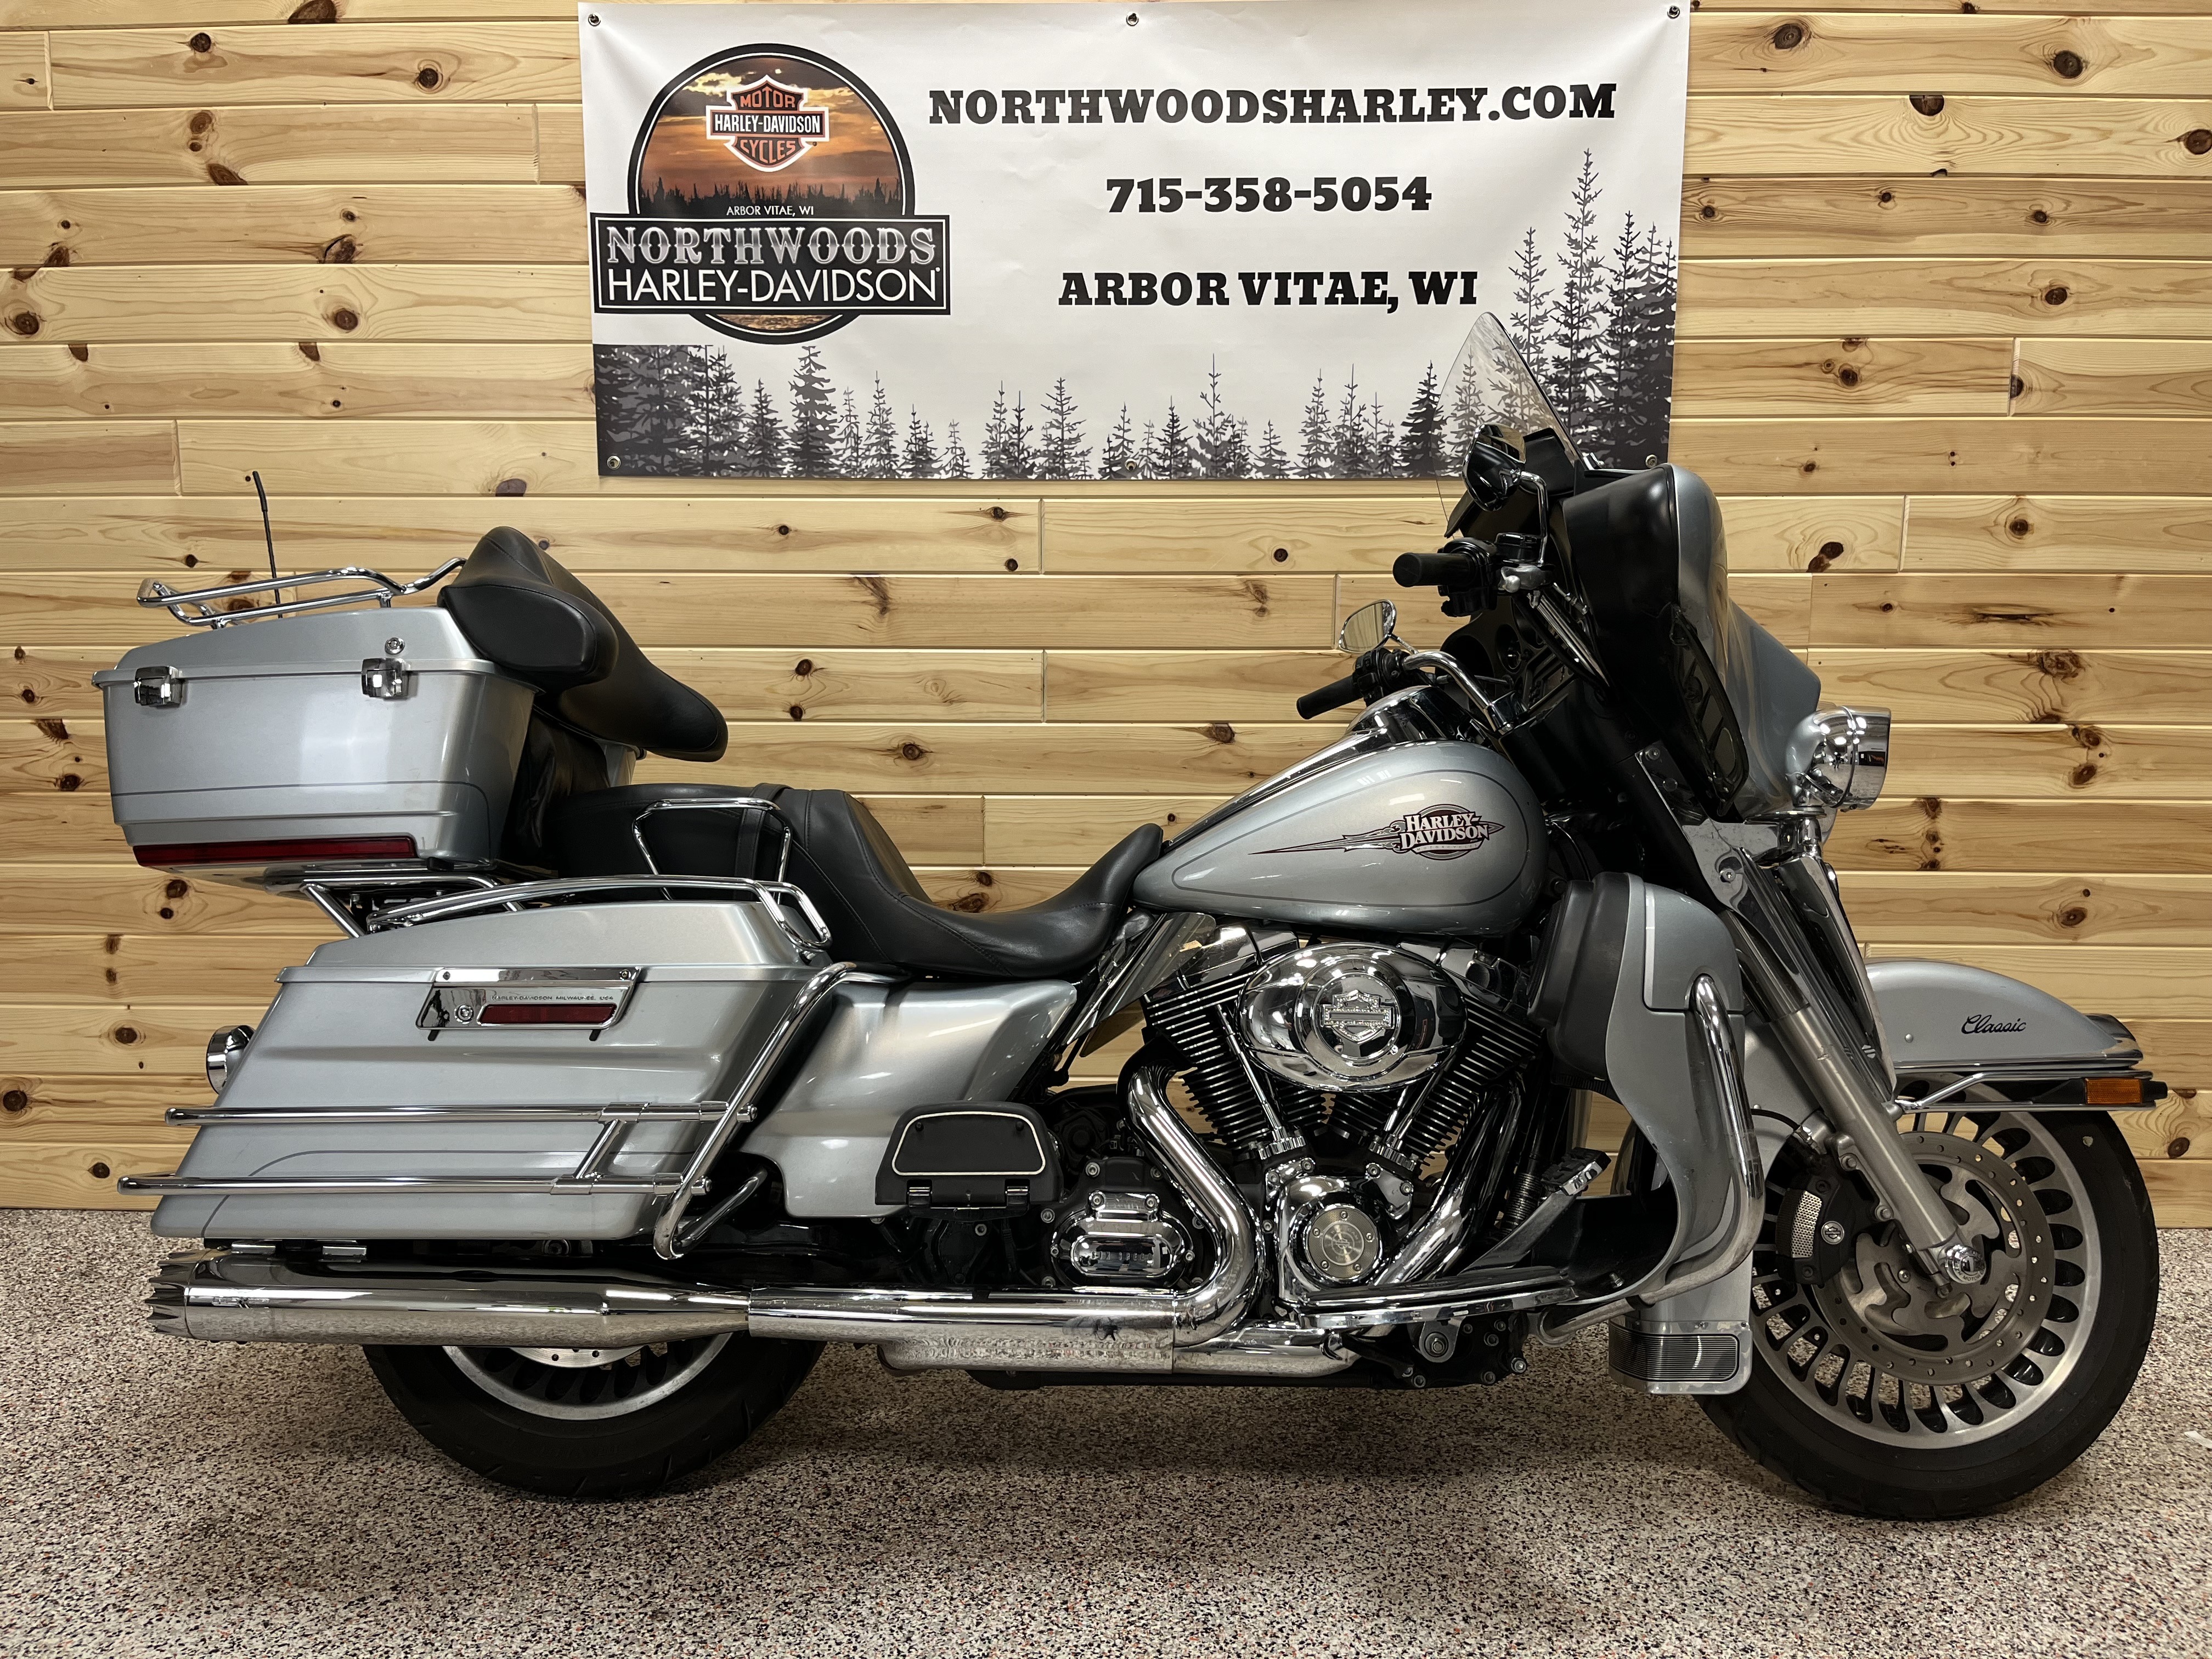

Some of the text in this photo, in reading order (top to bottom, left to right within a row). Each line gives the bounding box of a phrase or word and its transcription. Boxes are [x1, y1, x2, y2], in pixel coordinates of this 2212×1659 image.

[740, 86, 795, 108] MOTOR
[929, 83, 1617, 125] NORTHWOODSHARLEY.COM
[714, 114, 820, 133] HARLEY-DAVIDSON
[740, 139, 795, 163] CYCLES
[1107, 176, 1432, 213] 715-358-5054
[726, 205, 814, 217] ARBOR VITAE, WI
[606, 226, 935, 265] NORTHWOODS
[608, 269, 935, 302] HARLEY-DAVIDSON
[1058, 271, 1478, 314] ARBOR VITAE, WI
[1404, 813, 1480, 832] HARLEY-
[1400, 825, 1488, 850] DAVIDSON
[1961, 1014, 2027, 1035] Classic
